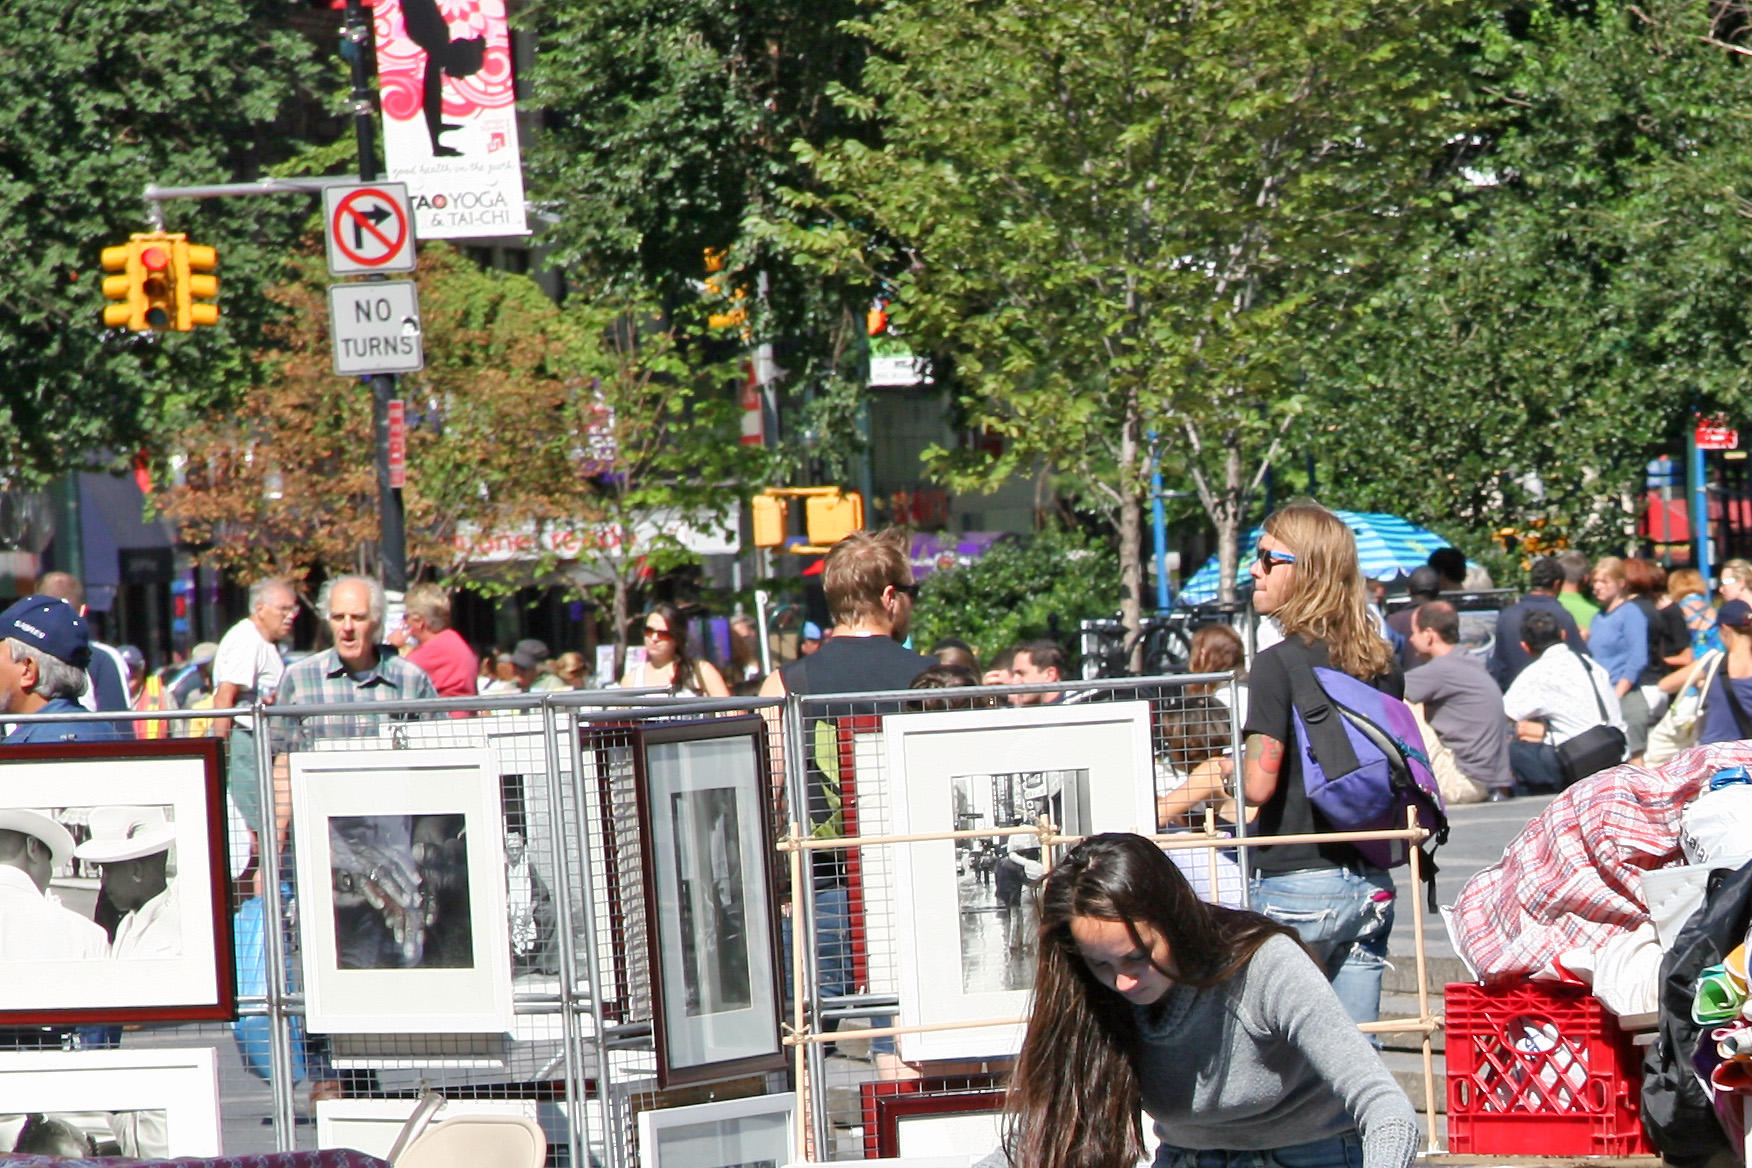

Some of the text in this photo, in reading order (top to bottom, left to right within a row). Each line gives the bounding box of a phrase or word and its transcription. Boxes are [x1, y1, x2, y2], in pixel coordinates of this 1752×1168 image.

[449, 191, 507, 209] YOGA
[431, 210, 510, 226] & TAI-CHI
[354, 298, 392, 323] NO
[341, 335, 413, 358] TURNS
